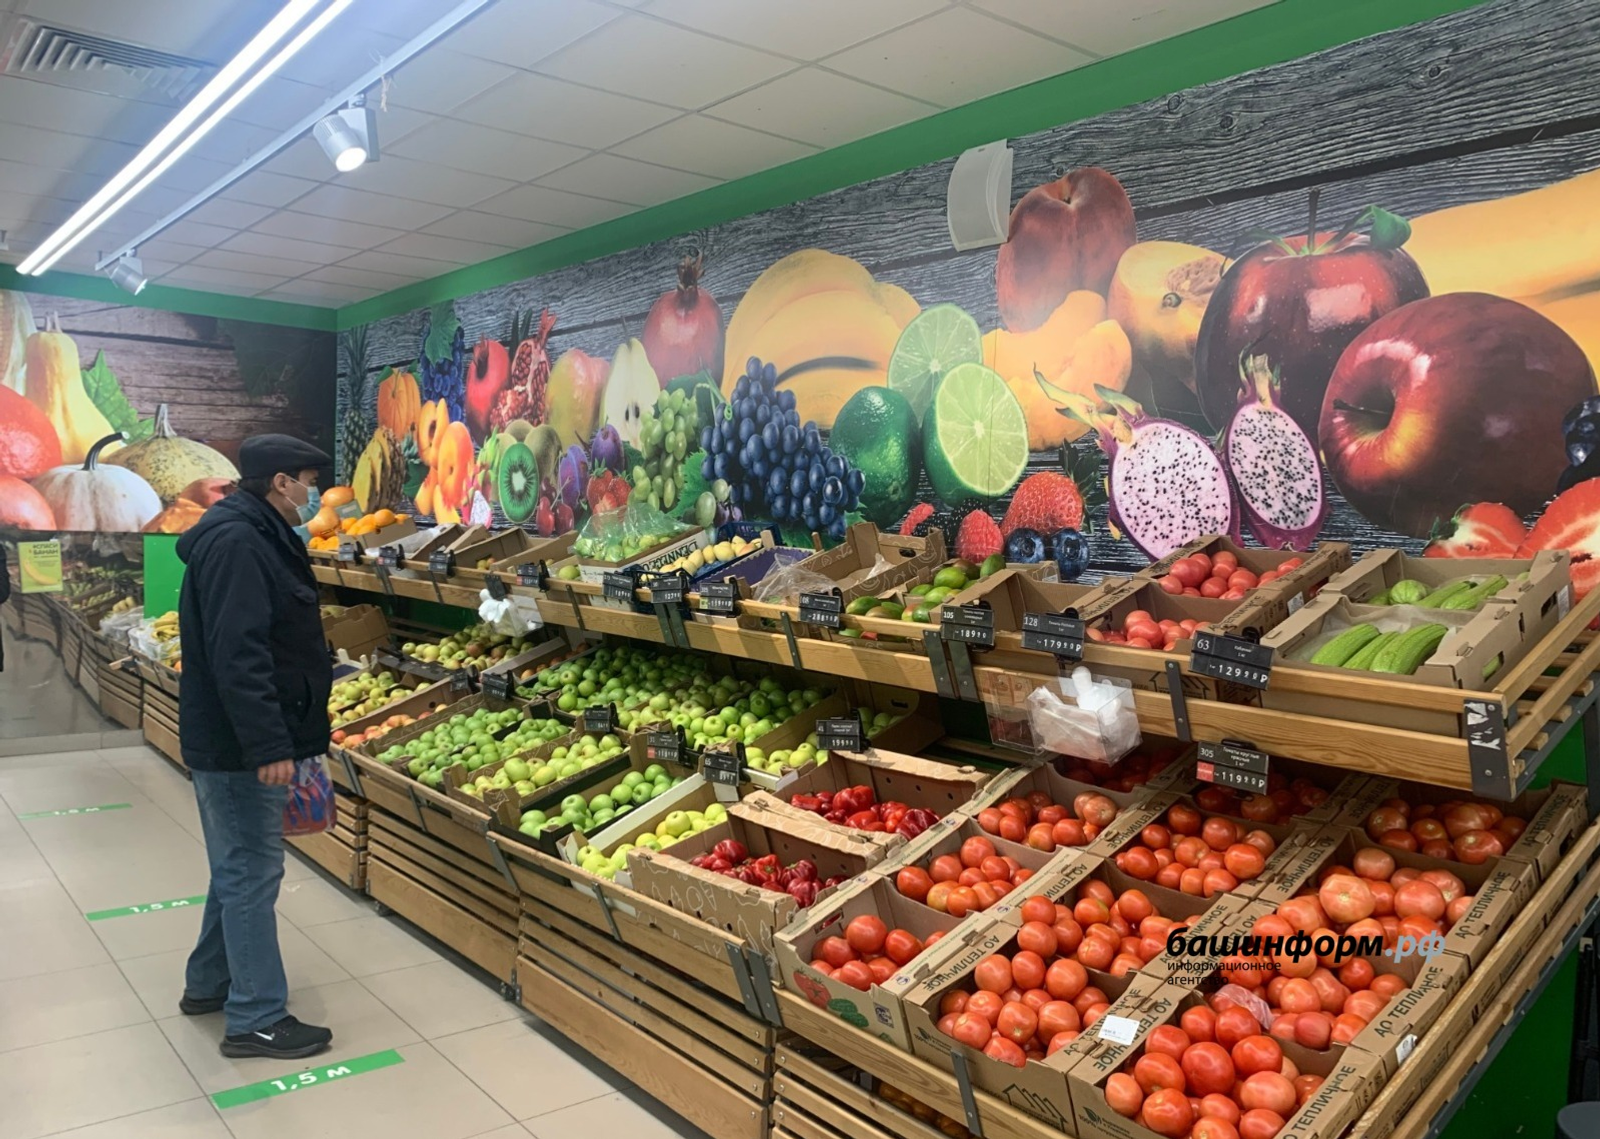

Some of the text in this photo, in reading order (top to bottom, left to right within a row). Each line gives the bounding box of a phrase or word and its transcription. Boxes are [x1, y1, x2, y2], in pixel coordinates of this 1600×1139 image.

[1023, 616, 1038, 627] 128
[1197, 639, 1210, 651] 63
[1200, 747, 1214, 758] 305
[1277, 846, 1327, 894] ТЕПЛИЧНОЕ
[1465, 870, 1512, 924] ТЕПЛИЧНОЕ
[129, 902, 165, 913] 1,5
[983, 934, 1000, 949] АО
[922, 947, 987, 992] ТЕПЛИЧНОЕ
[1153, 997, 1173, 1014] АО
[270, 1071, 318, 1092] 1,5
[1291, 1065, 1357, 1132] ТЕПЛИЧНОЕ
